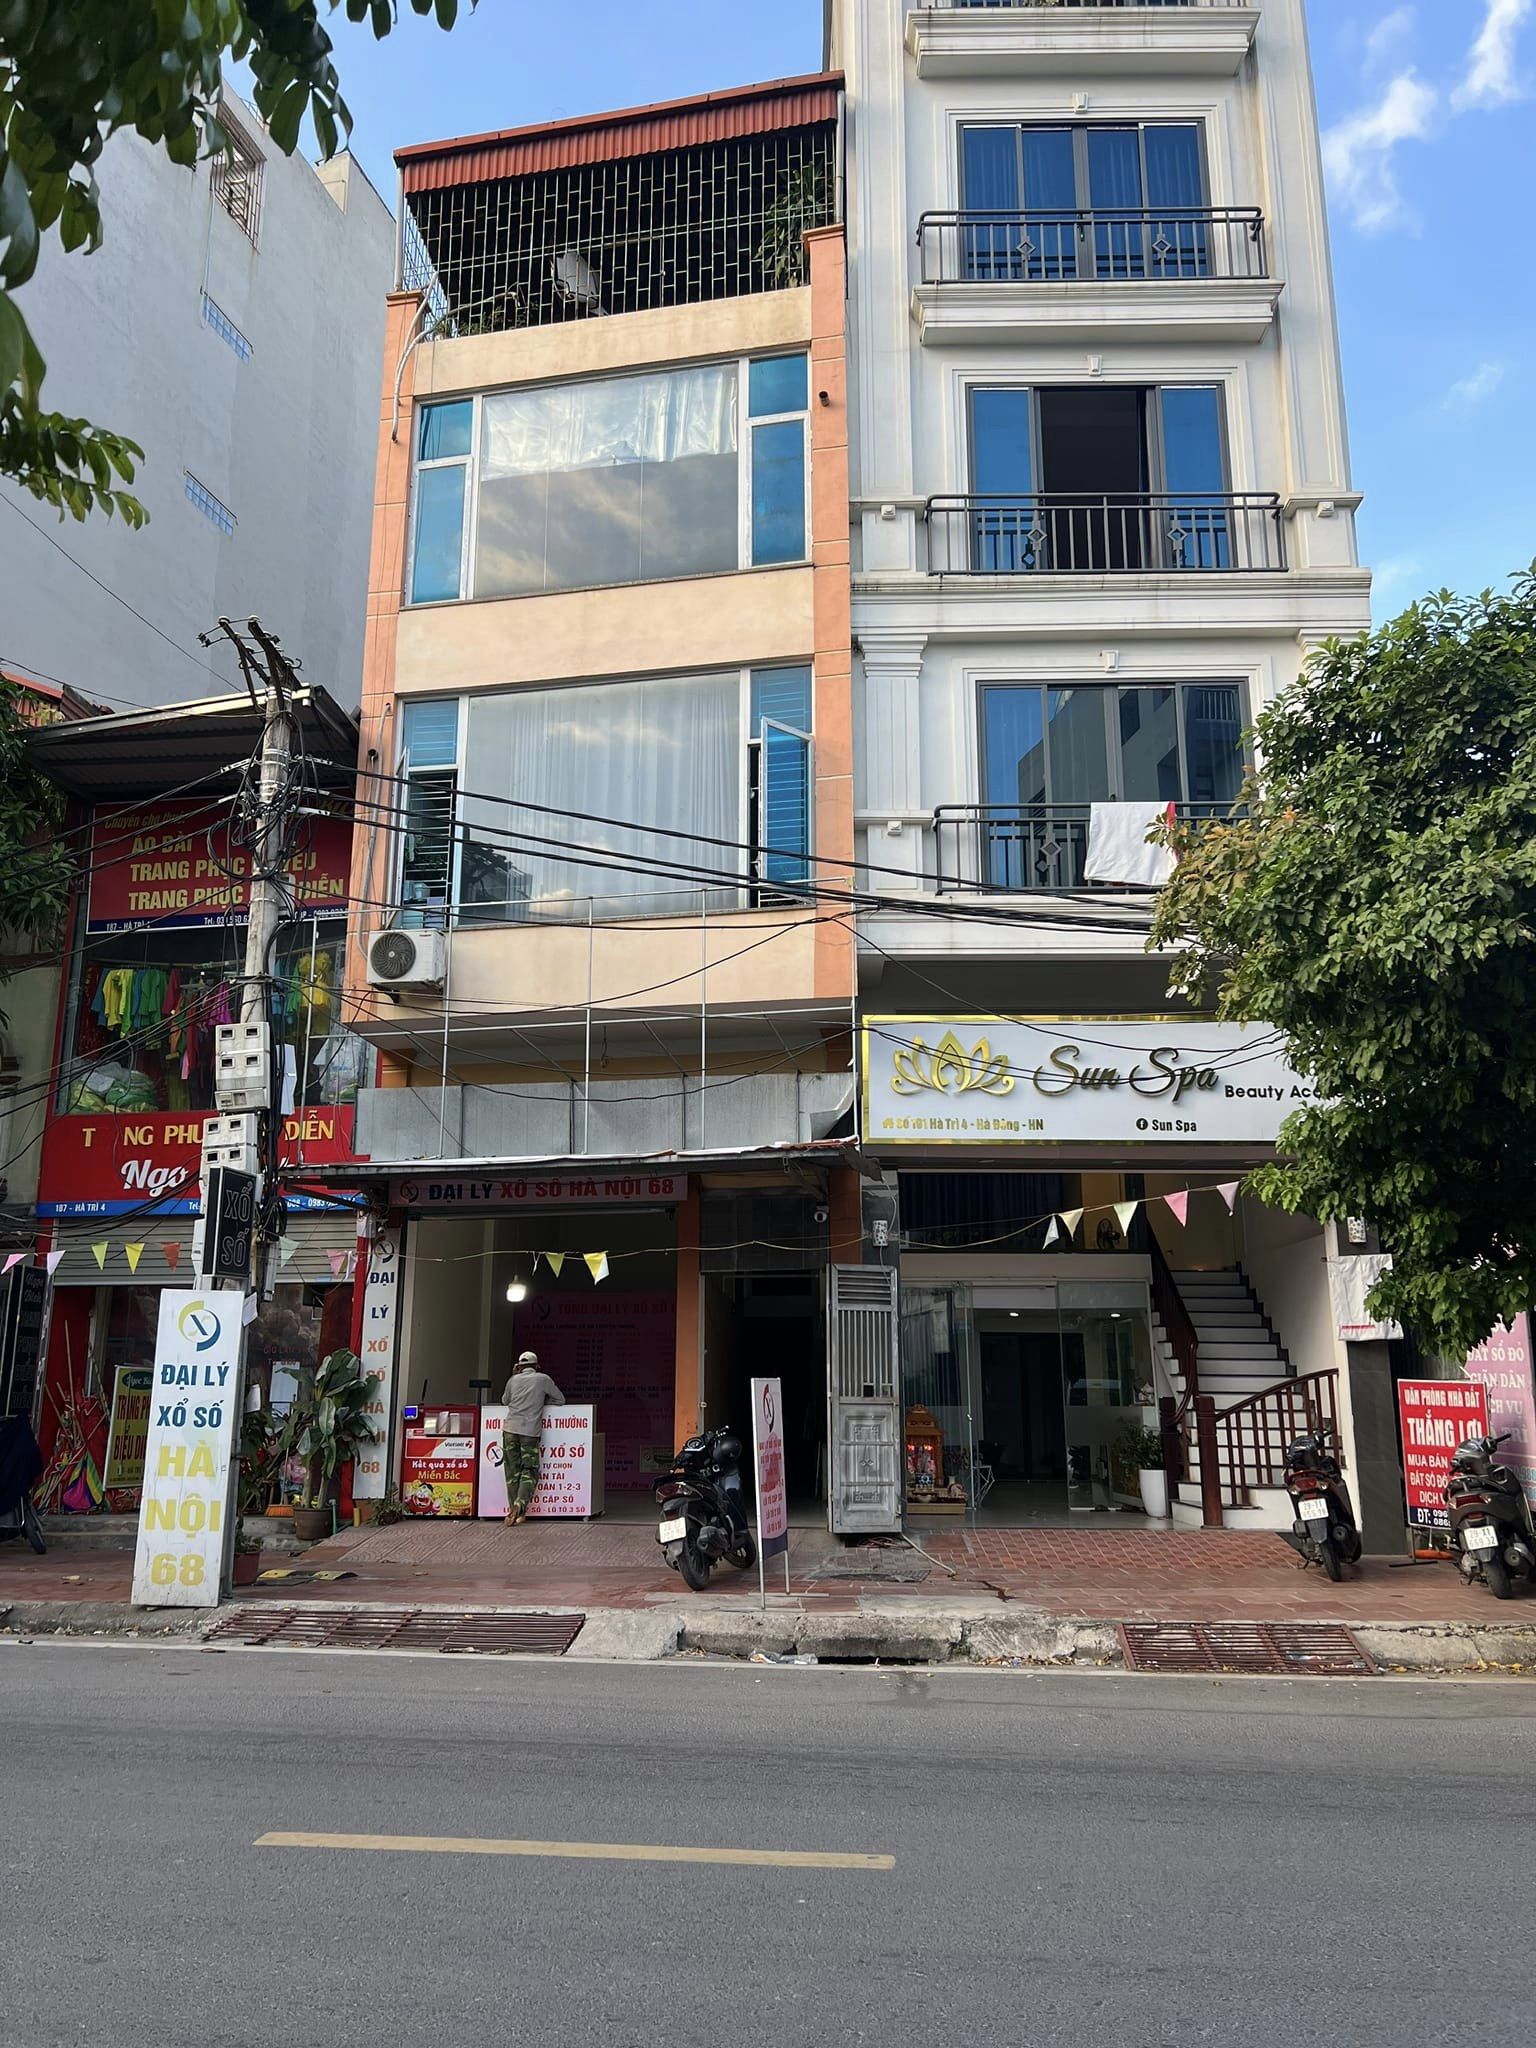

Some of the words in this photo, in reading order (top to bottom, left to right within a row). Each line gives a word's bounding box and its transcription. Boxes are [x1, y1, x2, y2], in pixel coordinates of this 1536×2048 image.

[130, 860, 190, 882] TRANG
[195, 857, 245, 880] PHỤC
[128, 889, 188, 911] TRANG
[193, 885, 243, 909] PHỤC
[298, 872, 344, 900] DIỄN
[1032, 1044, 1121, 1097] Sun
[1128, 1046, 1219, 1105] Spa
[1224, 1084, 1284, 1102] Beauty
[284, 1109, 333, 1141] DIỄN
[929, 1116, 944, 1130] Hà
[945, 1116, 959, 1130] Trì
[960, 1118, 968, 1130] 4
[976, 1117, 990, 1130] Hà
[992, 1118, 1020, 1131] Đông
[1028, 1118, 1044, 1130] HN
[1151, 1119, 1173, 1131] Sun
[1175, 1119, 1197, 1132] Spa
[429, 1183, 463, 1203] ĐẠI
[569, 1176, 597, 1196] HÀ
[604, 1177, 641, 1199] NỘI
[649, 1178, 674, 1195] 68
[55, 1204, 67, 1212] 187
[74, 1202, 85, 1212] HÀ
[87, 1201, 98, 1212] TRÌ
[100, 1203, 106, 1212] 4
[224, 1180, 253, 1222] XỔ
[221, 1228, 250, 1267] SỐ
[370, 1271, 395, 1286] ĐẠI
[371, 1304, 389, 1319] LÝ
[367, 1335, 389, 1352] XỔ
[1508, 1342, 1525, 1361] ĐỎ
[160, 1363, 198, 1391] ĐẠI
[205, 1361, 230, 1386] LÝ
[1501, 1369, 1526, 1388] DÂN
[1404, 1386, 1419, 1405] VĂN
[1421, 1387, 1447, 1407] PHÒNG
[1448, 1387, 1464, 1407] NHÀ
[1464, 1385, 1480, 1408] ĐẤT
[156, 1397, 189, 1427] XỔ
[193, 1400, 224, 1428] SỐ
[363, 1400, 385, 1414] HÀ
[1506, 1400, 1524, 1418] VỤ
[485, 1418, 500, 1430] NƠI
[540, 1415, 552, 1429] RẢ
[555, 1414, 588, 1429] THƯỞNG
[1407, 1408, 1456, 1448] THẮNG
[549, 1442, 566, 1458] XỔ
[569, 1442, 585, 1458] SỐ
[157, 1440, 216, 1478] HÀ
[360, 1461, 380, 1474] 68
[412, 1459, 426, 1469] Kết
[428, 1459, 445, 1470] quả
[552, 1462, 573, 1471] CHỌN
[1407, 1453, 1428, 1467] MUA
[1428, 1454, 1449, 1468] BÁN
[418, 1470, 442, 1480] Miền
[443, 1470, 461, 1480] Bắc
[1410, 1471, 1425, 1486] ĐẤT
[1425, 1473, 1437, 1488] SỔ
[537, 1482, 556, 1491] OÁN
[558, 1483, 581, 1491] 1-2-3
[1419, 1491, 1439, 1507] DỊCH
[145, 1494, 221, 1539] NỘI
[1417, 1507, 1432, 1524] ĐT:
[151, 1553, 204, 1586] 68
